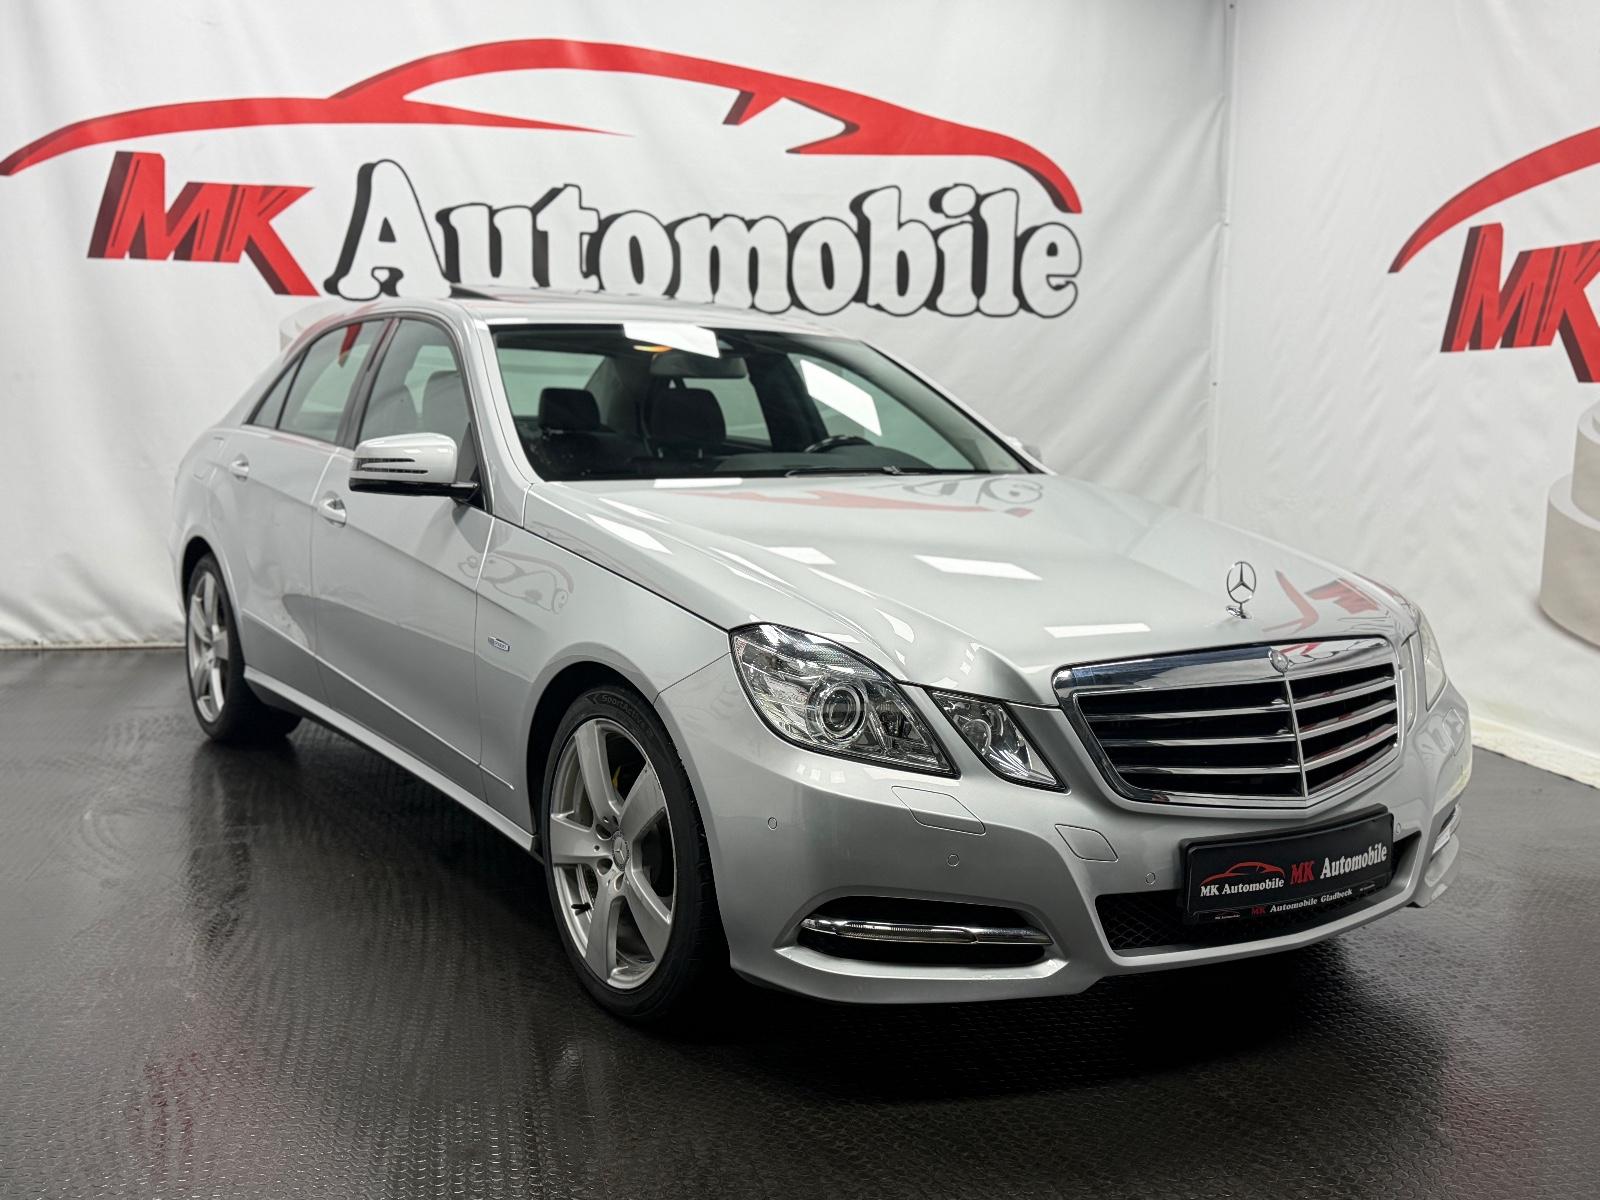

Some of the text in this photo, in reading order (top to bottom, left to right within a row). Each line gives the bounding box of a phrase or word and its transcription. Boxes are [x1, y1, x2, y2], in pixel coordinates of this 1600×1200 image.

[87, 150, 1082, 318] MK Automobile
[1440, 222, 1600, 383] MK
[1290, 842, 1388, 886] MK Automobile
[1200, 877, 1285, 897] MK Automobile
[1270, 898, 1318, 913] Automobile
[1320, 888, 1353, 903] Gladbeck
